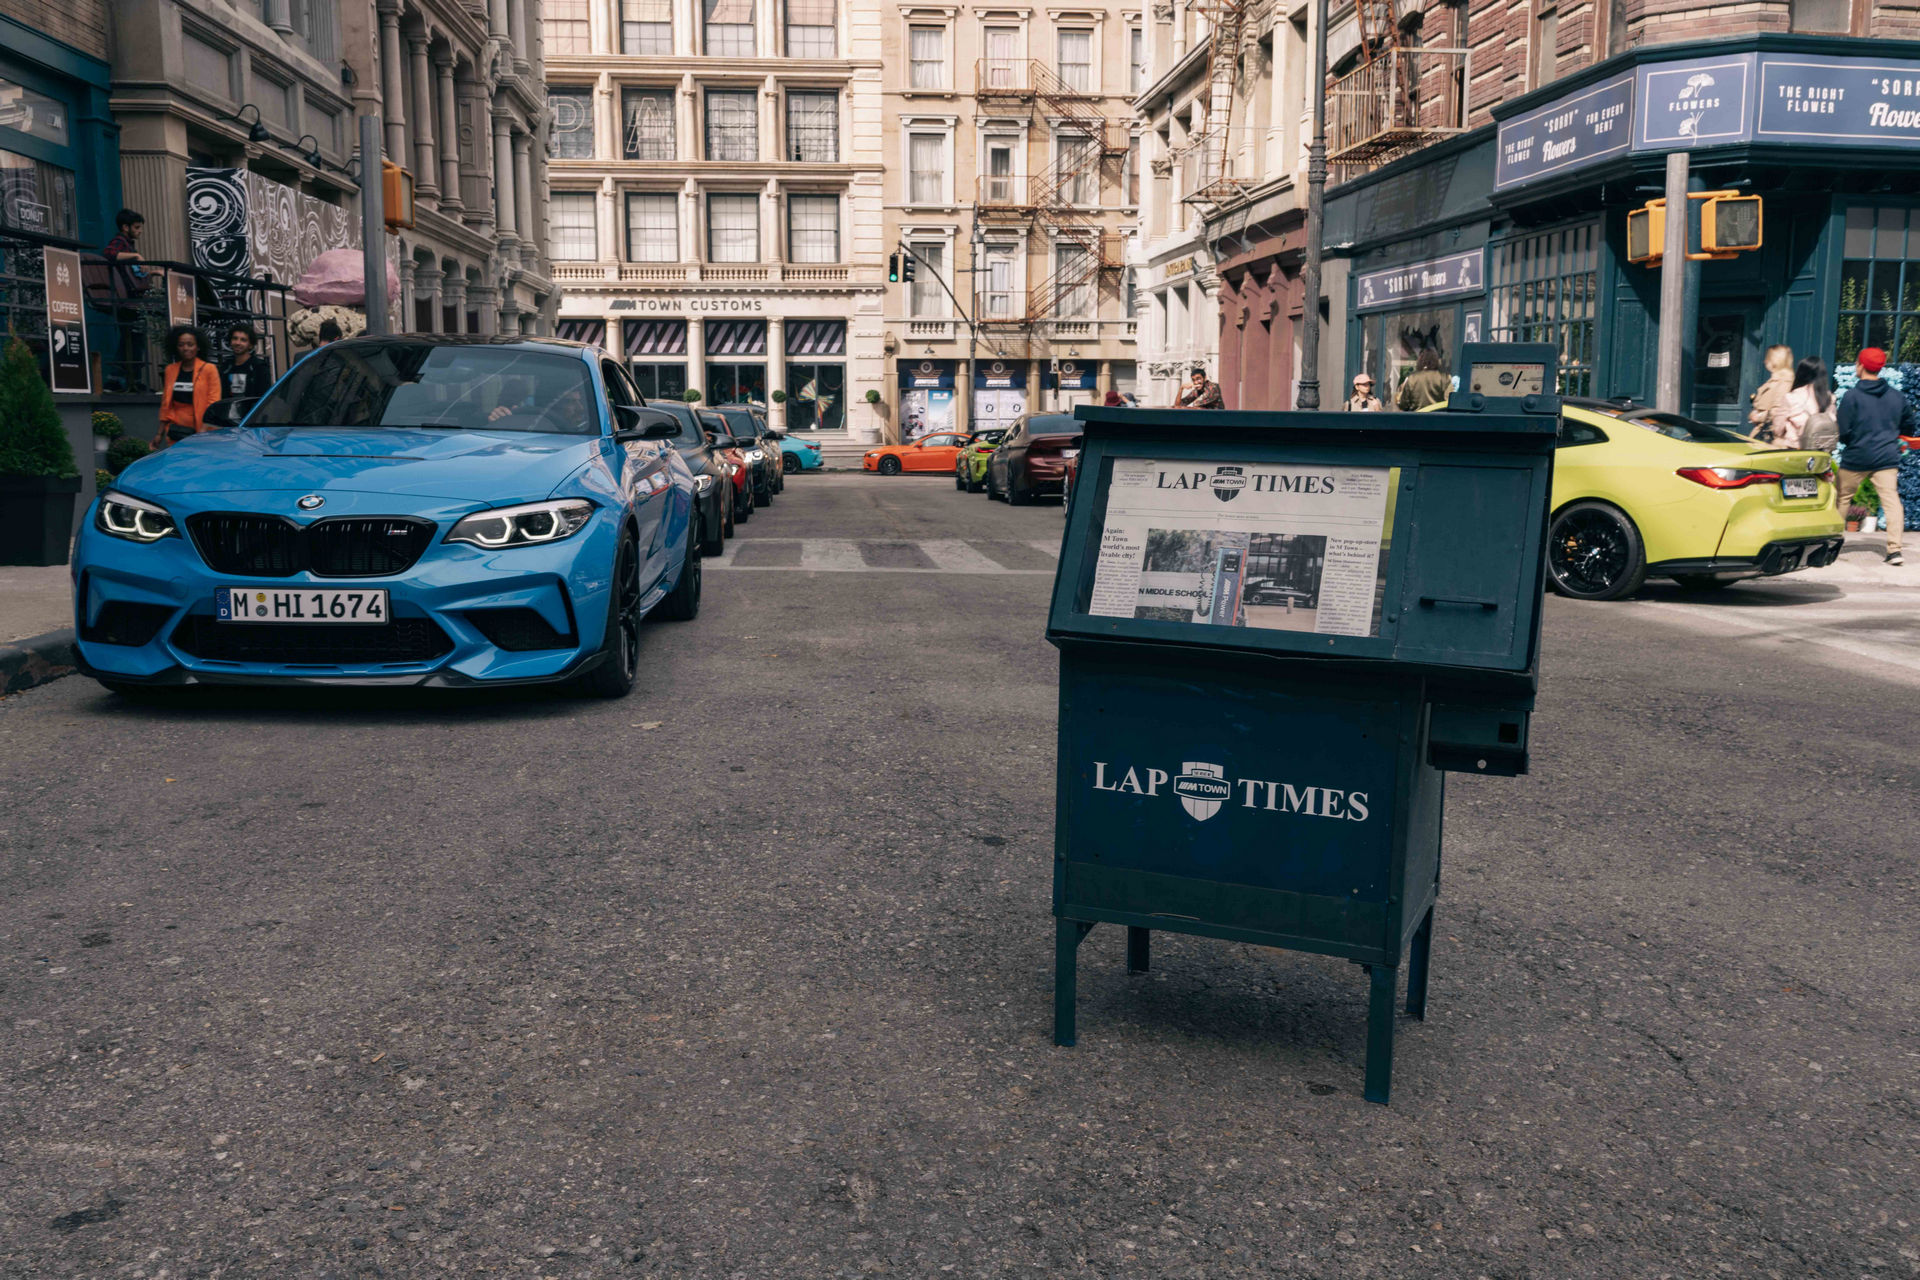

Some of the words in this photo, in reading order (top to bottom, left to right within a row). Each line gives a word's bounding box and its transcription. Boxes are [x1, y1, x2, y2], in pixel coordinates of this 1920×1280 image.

[1779, 85, 1801, 98] THE
[1808, 87, 1845, 101] RIGHT
[1669, 98, 1721, 112] FLOWERS
[1787, 99, 1835, 114] FLOWER
[1586, 112, 1599, 126] FOR
[1601, 103, 1624, 120] EVERY
[1594, 119, 1613, 135] DENT
[1505, 142, 1515, 155] THE
[1517, 136, 1535, 151] RIGHT
[1542, 136, 1577, 162] Flowers
[1507, 149, 1530, 165] FLOWER
[20, 207, 44, 224] DONUT
[52, 300, 79, 315] COFFEE
[638, 300, 682, 310] TOWN
[690, 300, 762, 311] CUSTOMS
[1156, 471, 1207, 489] LAP
[1252, 474, 1335, 494] TIMES
[1105, 527, 1125, 535] Again:
[1145, 588, 1174, 596] MIDDLE
[233, 593, 249, 617] M
[1219, 595, 1229, 617] Power
[1092, 761, 1169, 797] LAP
[1199, 783, 1227, 795] TOWN
[1237, 778, 1369, 822] TIMES
